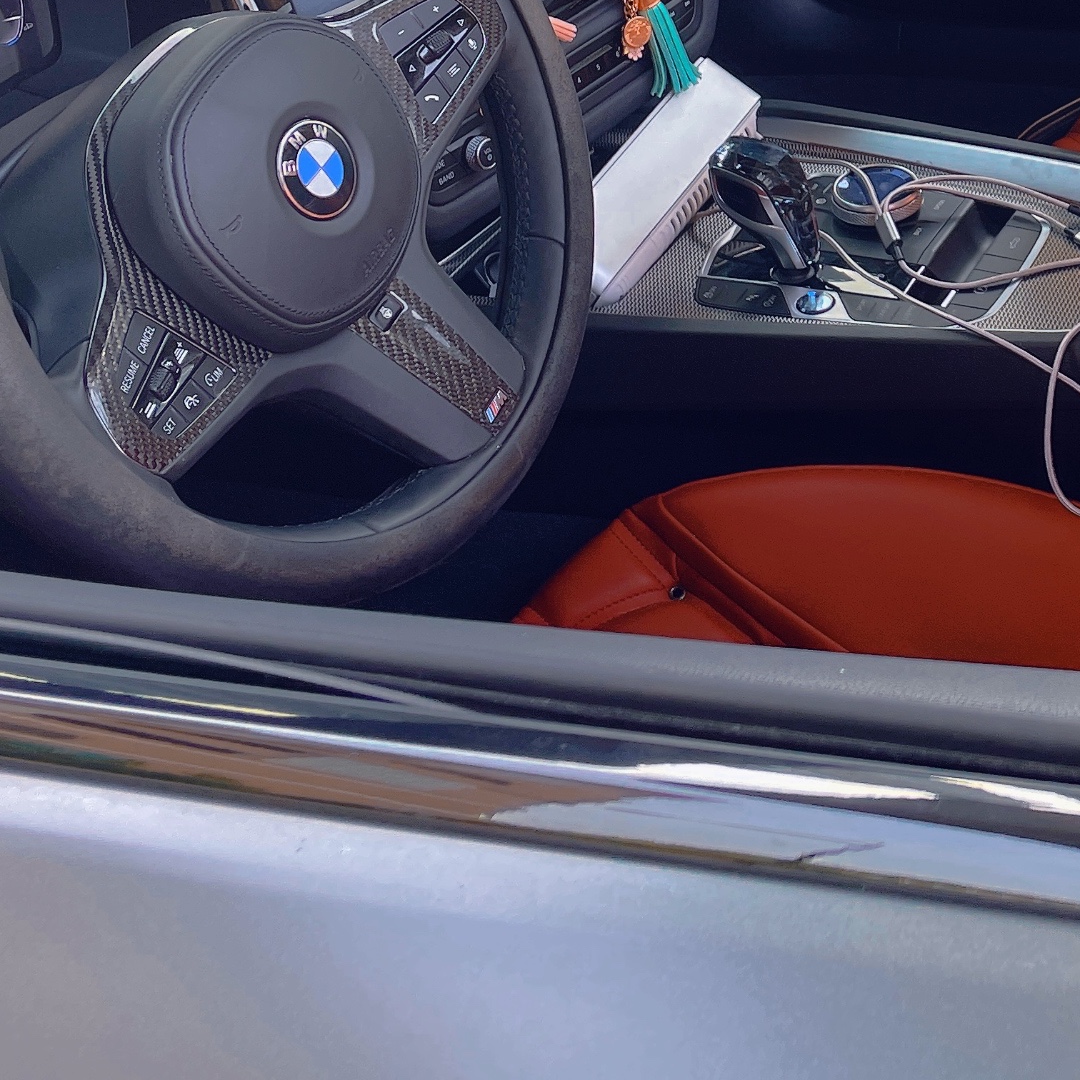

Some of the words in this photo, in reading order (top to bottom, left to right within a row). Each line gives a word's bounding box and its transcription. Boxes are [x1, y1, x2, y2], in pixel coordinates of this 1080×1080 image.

[281, 123, 328, 177] BMW
[438, 170, 456, 186] BAND
[137, 325, 156, 355] CANCEL
[120, 359, 141, 395] RESUME
[162, 417, 177, 435] SET
